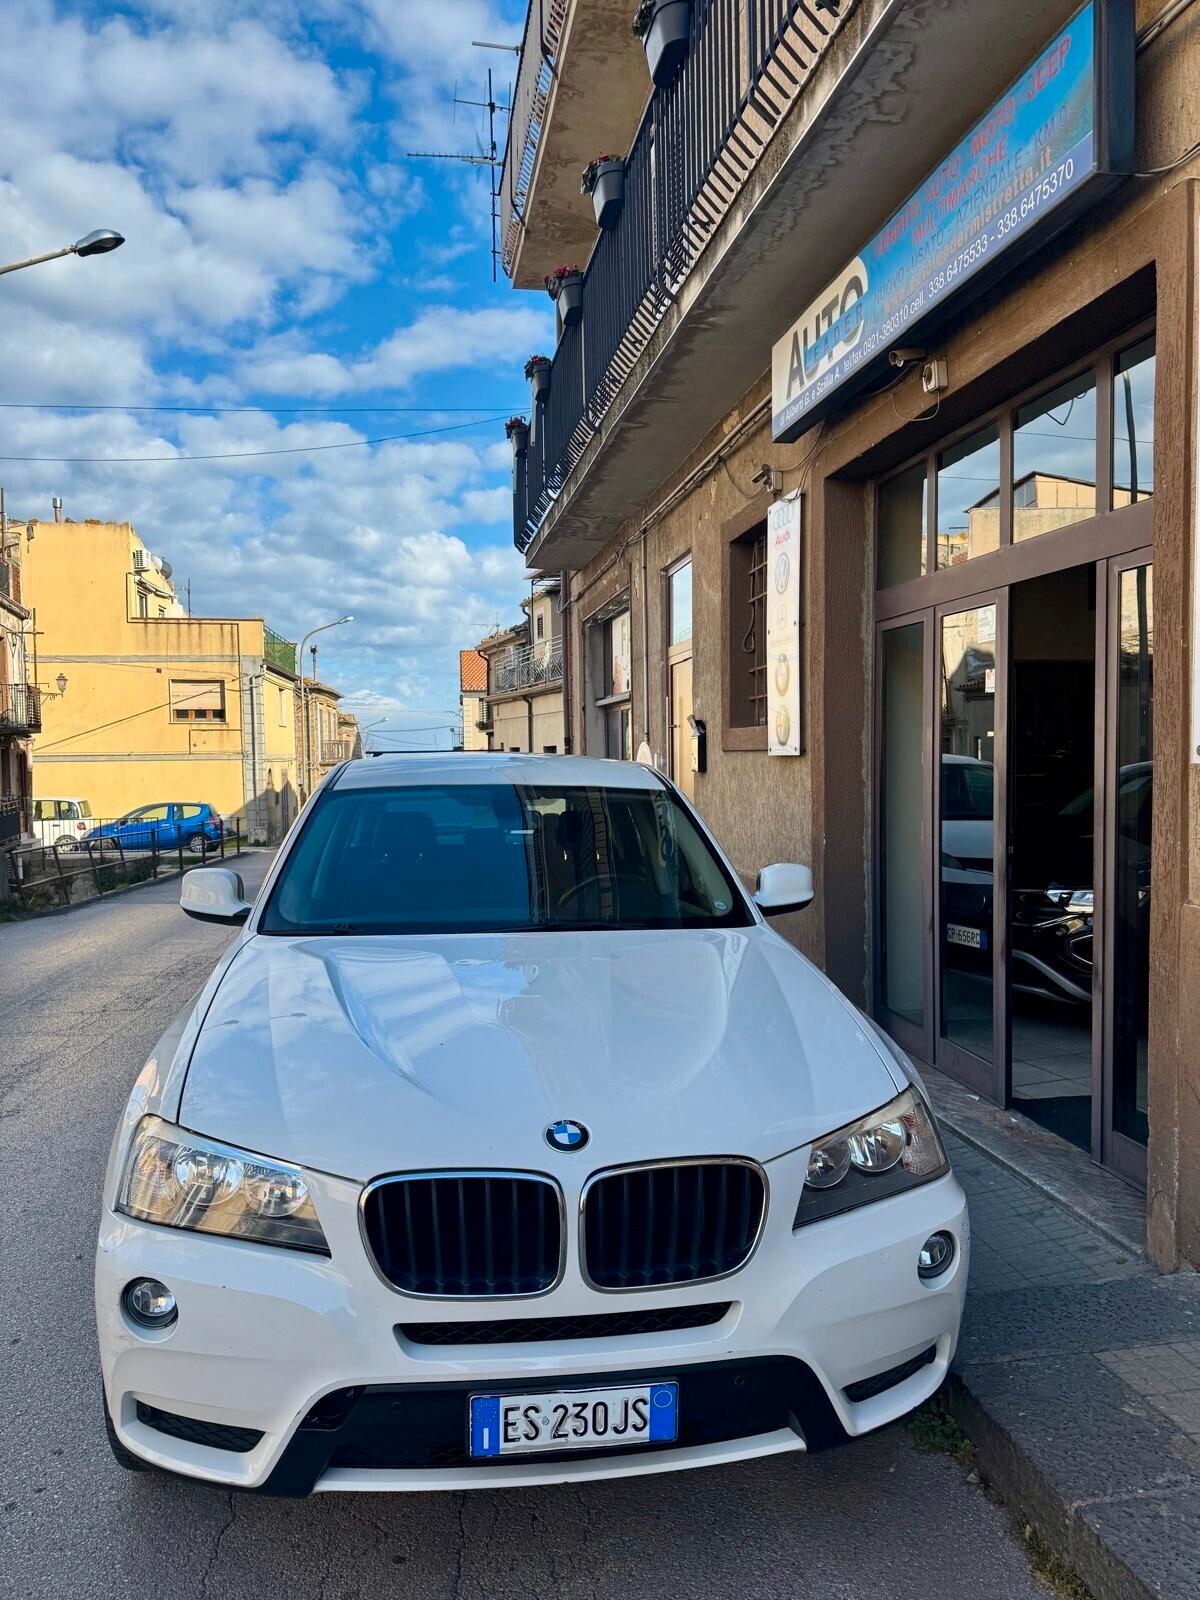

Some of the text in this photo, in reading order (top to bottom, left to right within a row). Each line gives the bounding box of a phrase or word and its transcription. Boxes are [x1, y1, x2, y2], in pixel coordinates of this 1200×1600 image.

[927, 155, 960, 201] AUTO
[971, 98, 1014, 157] MOTO
[1027, 36, 1071, 100] JEEP
[874, 266, 904, 304] NUOVO
[911, 228, 943, 268] USATO
[956, 148, 1023, 227] AZIENDALE
[910, 290, 925, 314] cell.
[928, 234, 987, 298] 338.6475533
[997, 158, 1073, 239] 338.6475370
[913, 134, 1007, 246] MULTIMARCHE
[786, 275, 864, 400] AUTO
[804, 304, 863, 369] LEADER
[775, 529, 791, 546] Audi
